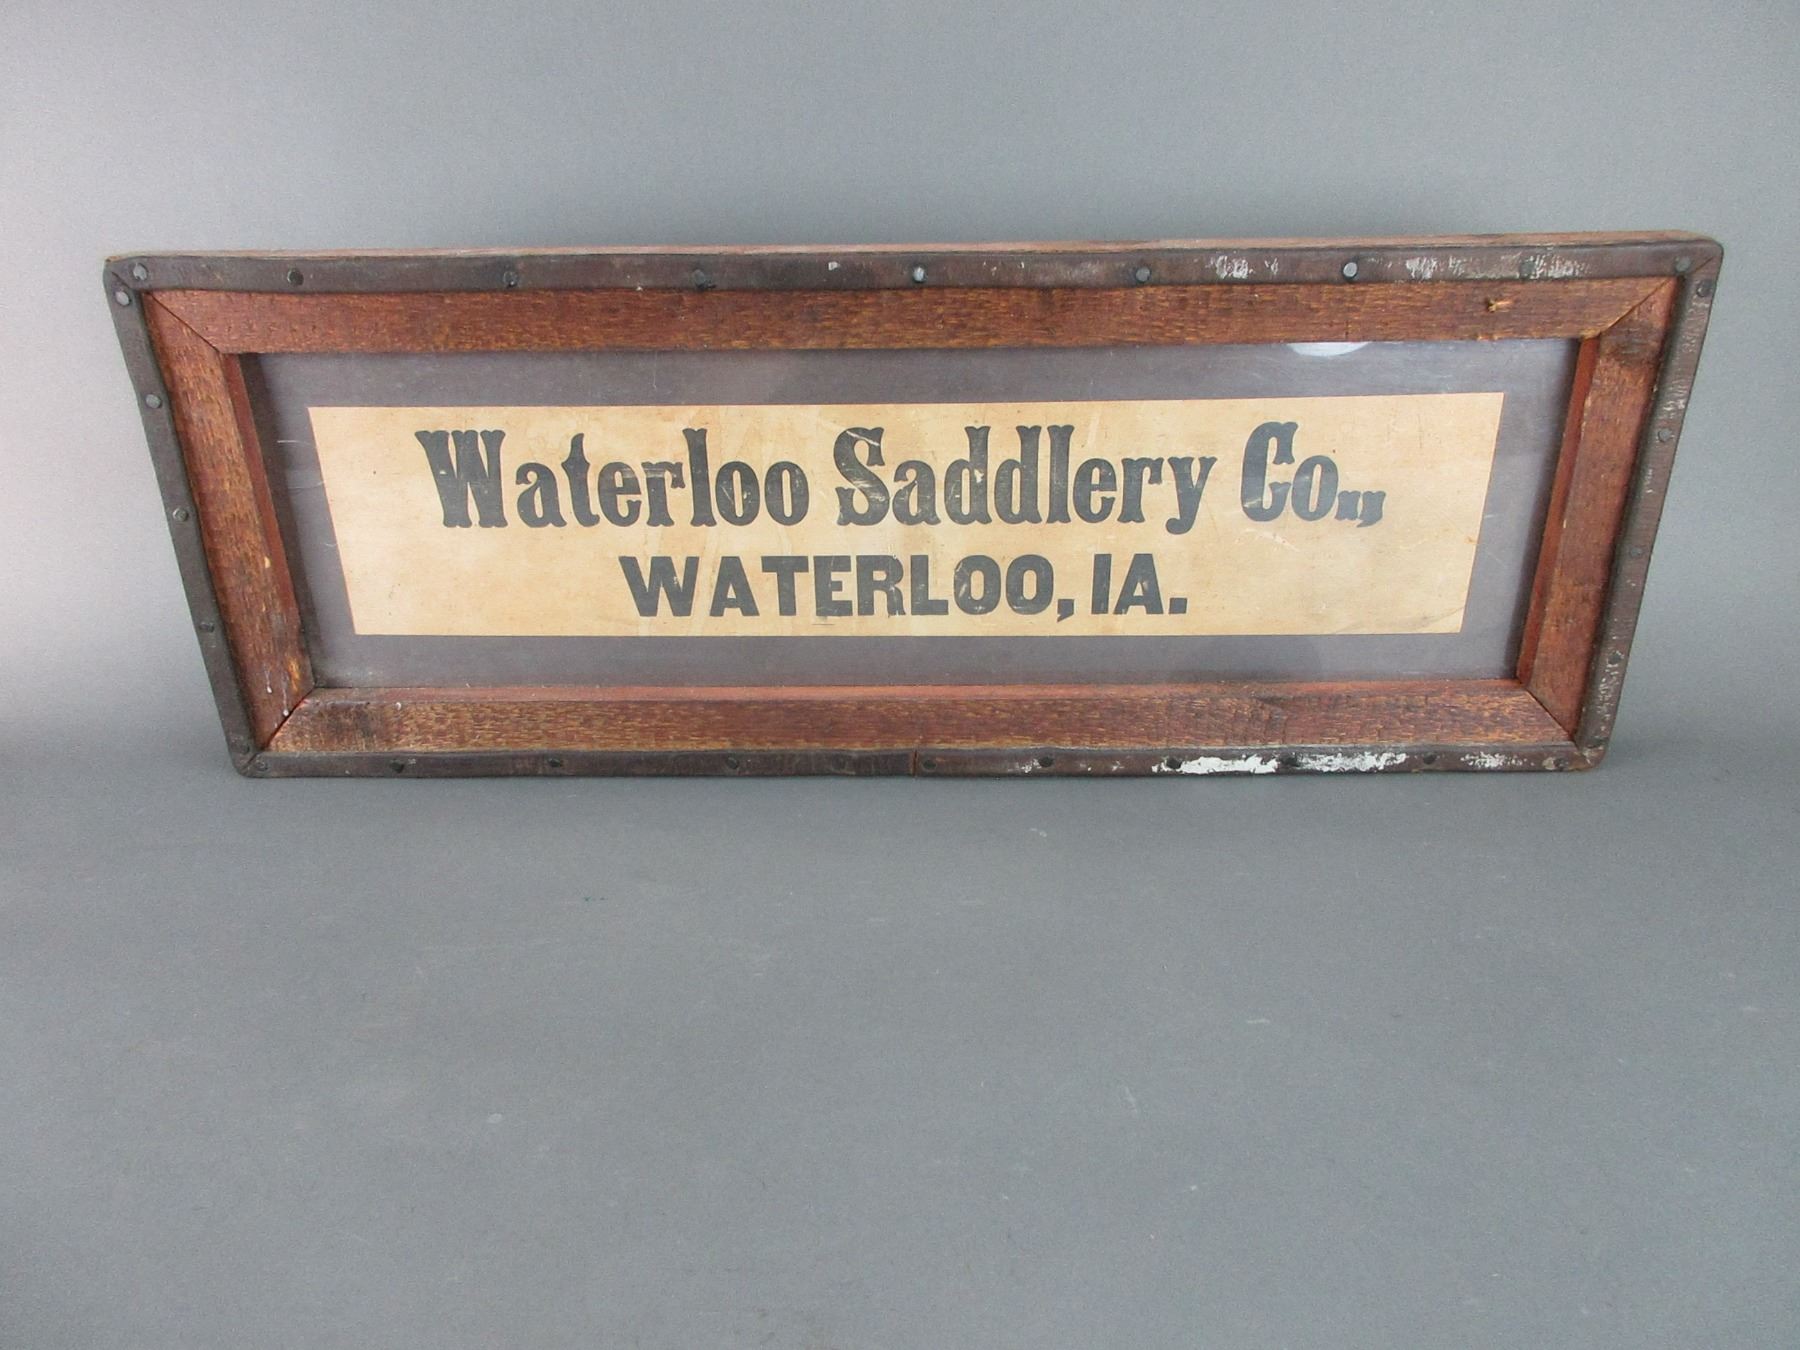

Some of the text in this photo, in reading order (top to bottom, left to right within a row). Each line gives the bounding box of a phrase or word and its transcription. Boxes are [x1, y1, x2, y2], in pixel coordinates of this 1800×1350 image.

[414, 427, 810, 528] Waterloo
[832, 424, 1218, 535] Saddlery
[618, 553, 1188, 623] WATERLOO, IA.
